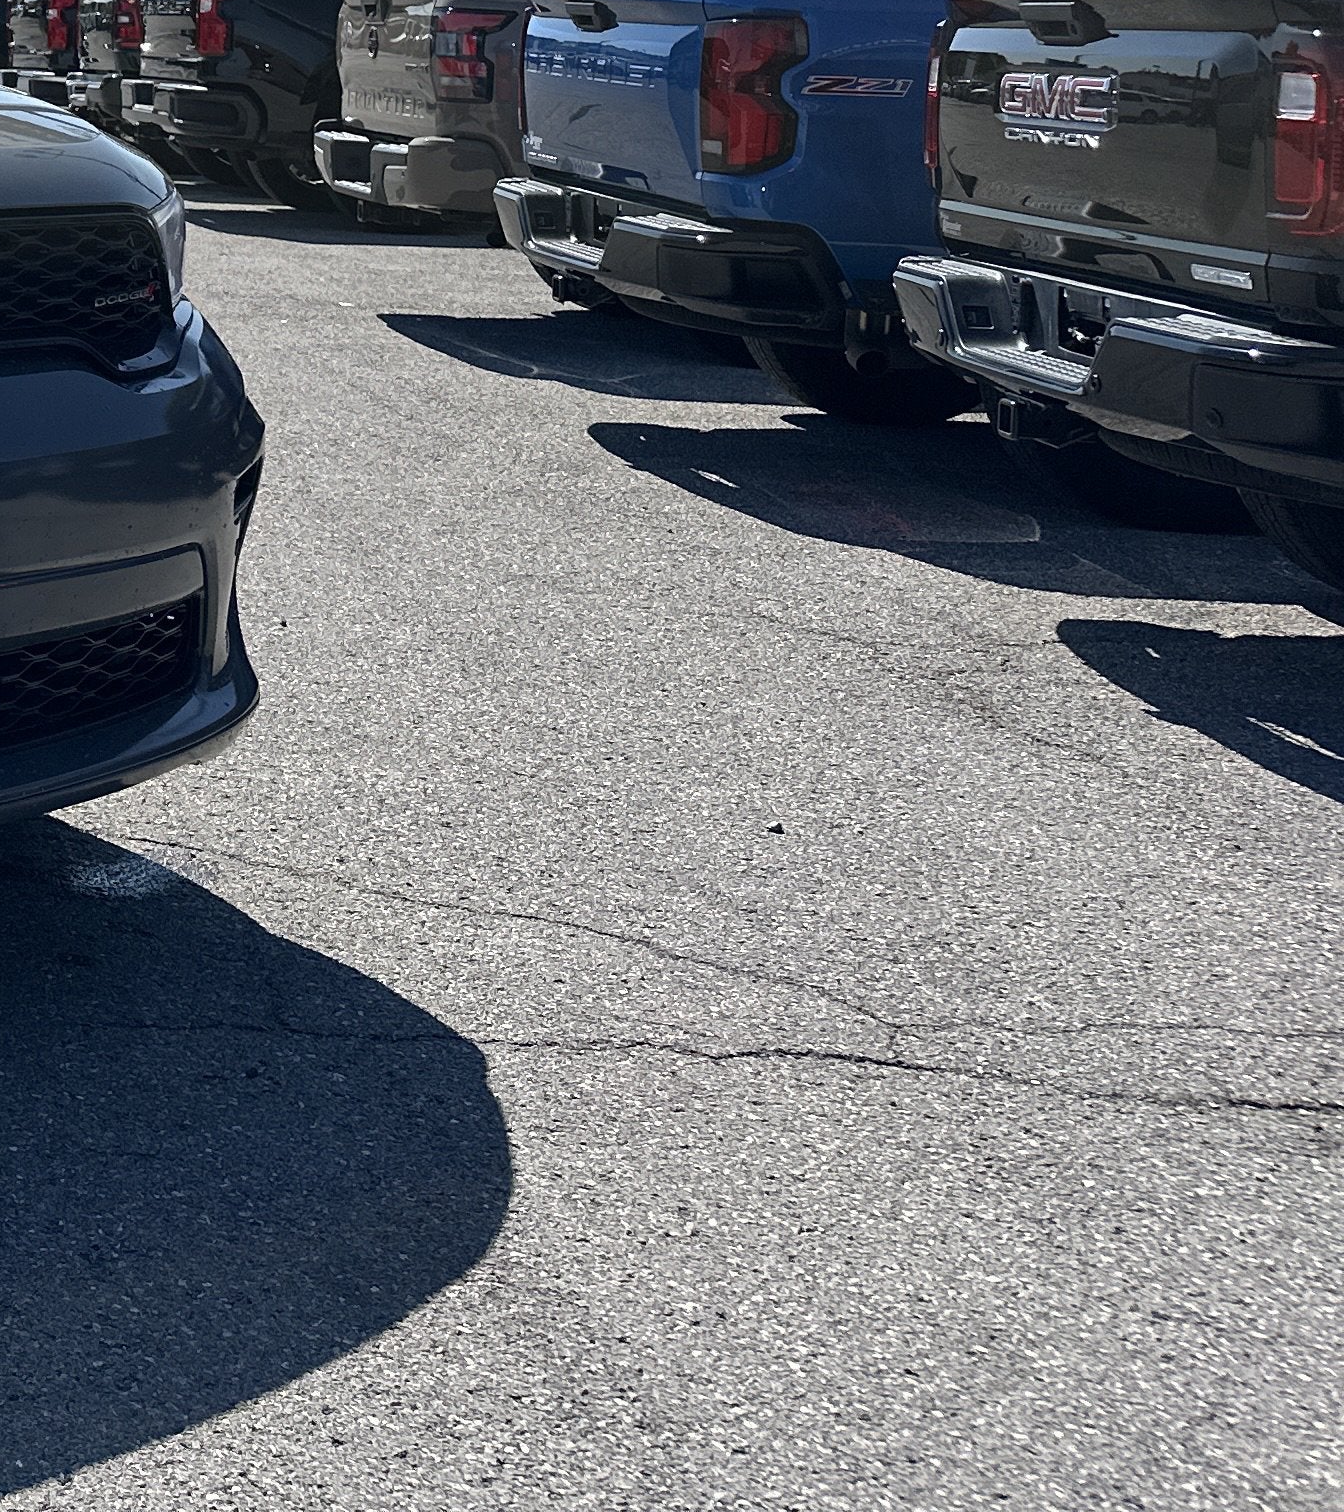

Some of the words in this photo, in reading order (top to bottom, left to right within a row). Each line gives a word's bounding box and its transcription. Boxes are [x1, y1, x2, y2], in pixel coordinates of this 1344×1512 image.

[800, 75, 914, 98] Z71
[999, 72, 1112, 123] GMC
[346, 89, 425, 119] FRONTIER
[1004, 127, 1100, 148] CANYON
[94, 289, 151, 307] DODGE
